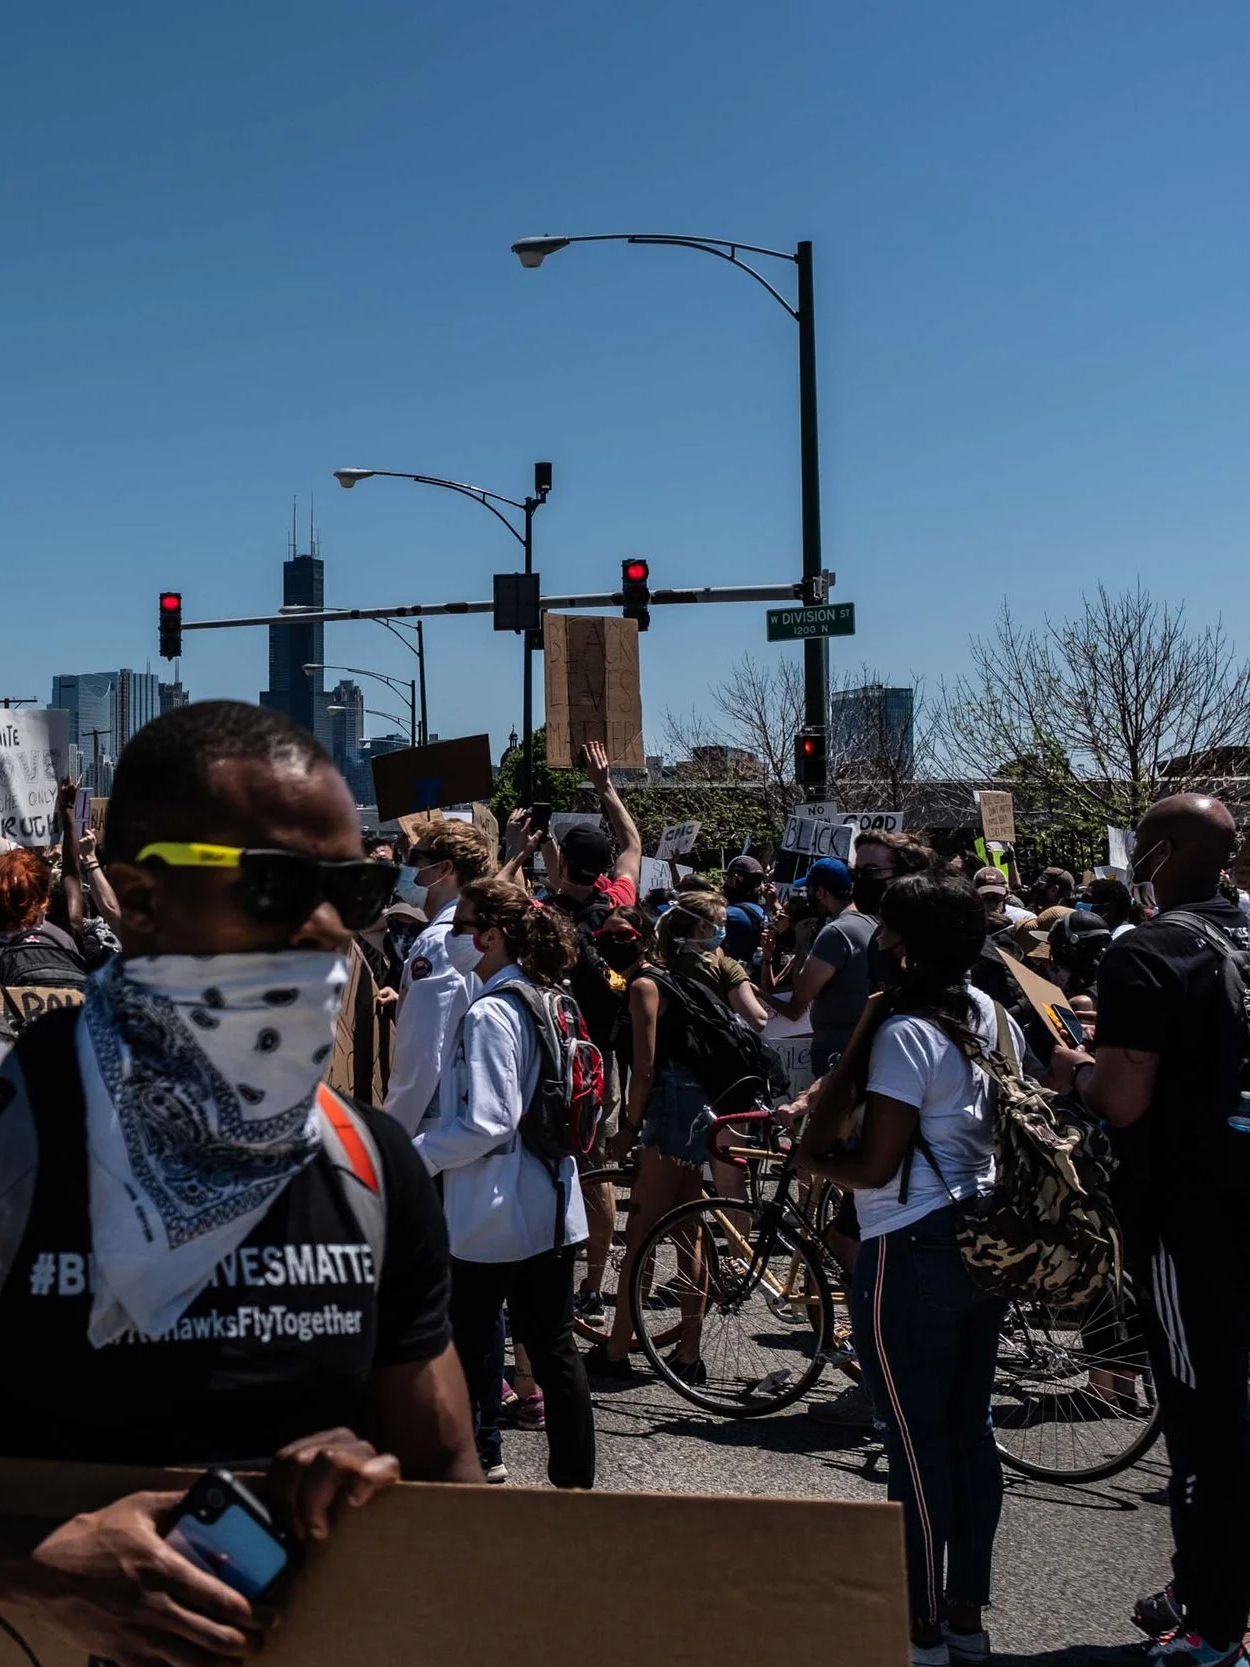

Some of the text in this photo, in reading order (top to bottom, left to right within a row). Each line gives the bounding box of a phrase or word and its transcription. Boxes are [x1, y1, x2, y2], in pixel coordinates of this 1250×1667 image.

[770, 608, 851, 625] W DIVISION ST
[793, 624, 829, 635] 1200 N
[28, 788, 57, 806] ONLY
[808, 806, 825, 816] NO
[785, 818, 841, 857] BLACK
